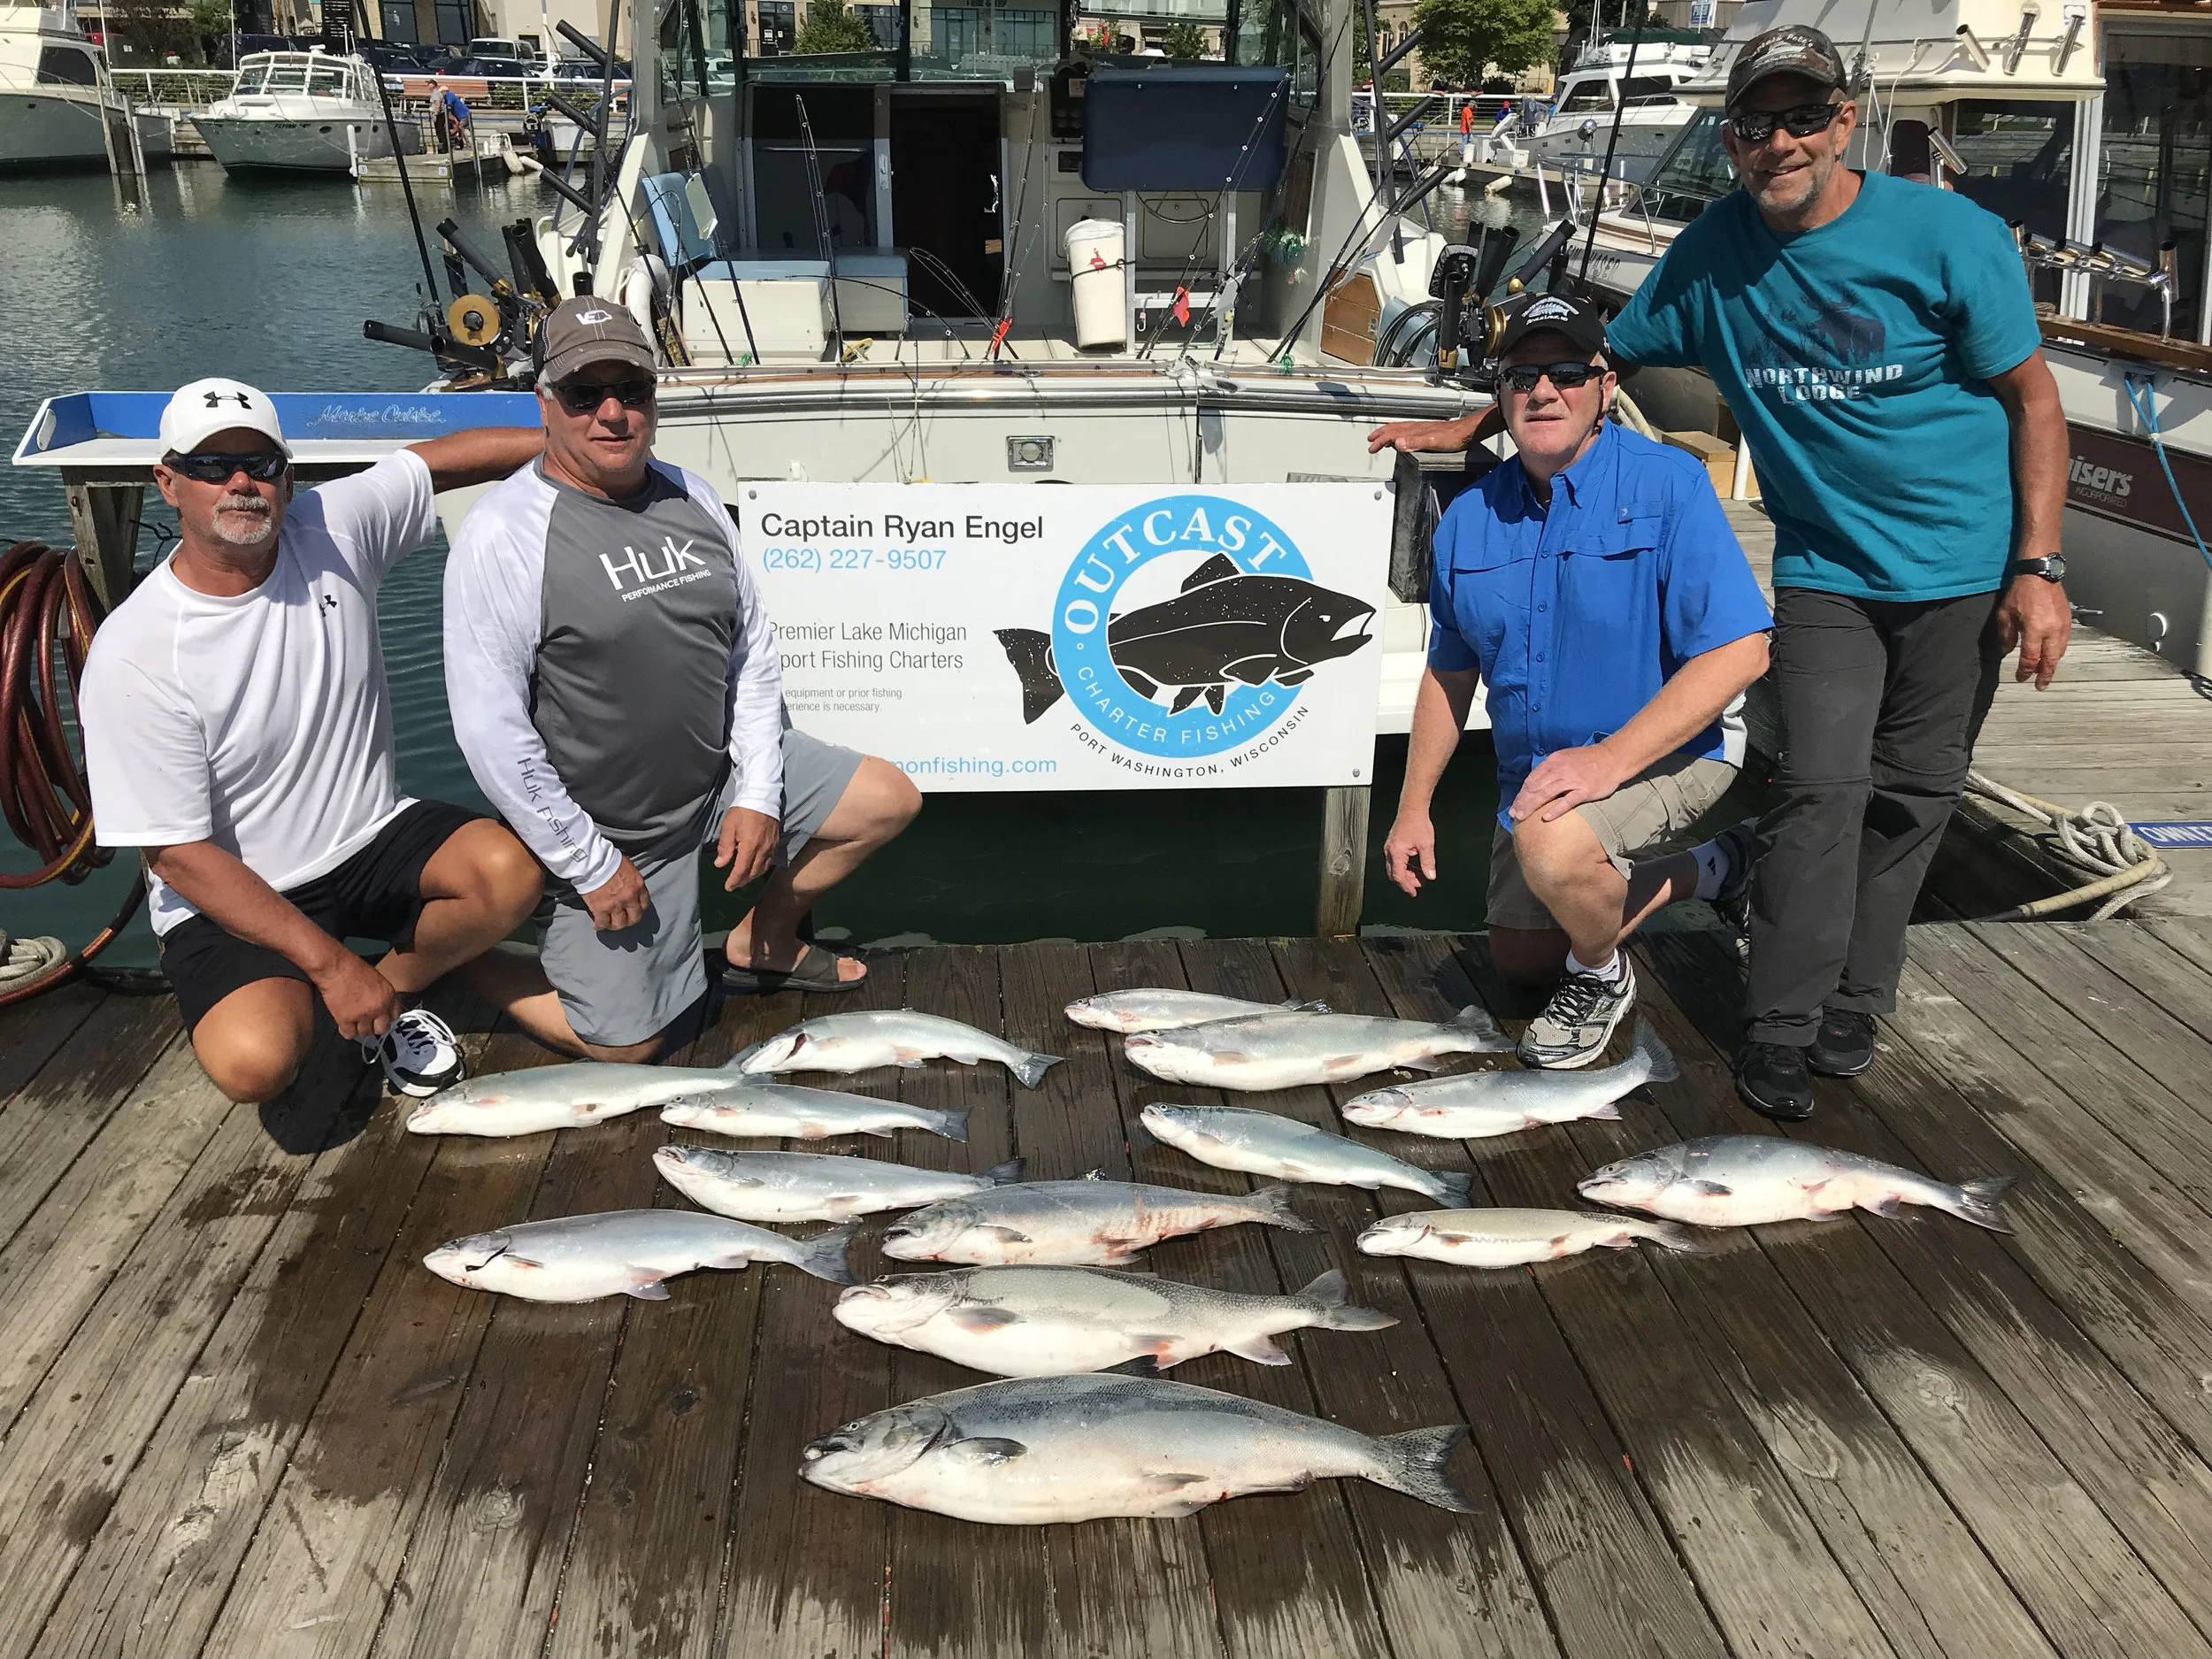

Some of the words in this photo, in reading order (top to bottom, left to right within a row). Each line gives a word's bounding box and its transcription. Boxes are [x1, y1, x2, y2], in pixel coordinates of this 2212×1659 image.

[1745, 364, 1904, 388] NORTHWIND
[1777, 383, 1863, 405] LODGE
[307, 404, 380, 427] Marine
[2075, 486, 2127, 508] INCORPORATED
[760, 512, 874, 542] Captain
[884, 514, 955, 544] Ryan
[965, 515, 1043, 545] Engel
[763, 548, 821, 573] (262)
[829, 549, 947, 570] 227-9507
[1064, 507, 1287, 634] OUTCAST
[679, 569, 712, 585] FISHING
[841, 622, 883, 641] Lake
[889, 622, 967, 645] Michigan
[777, 651, 816, 672] port
[822, 650, 883, 672] Fishing
[889, 650, 964, 669] Charters
[785, 687, 833, 699] equipment
[848, 687, 869, 700] prior
[872, 687, 902, 700] fishing
[1078, 666, 1167, 743] CHARTER
[1181, 691, 1276, 744] FISHING
[780, 702, 820, 712] perience
[823, 701, 832, 711] is
[1070, 723, 1108, 755] PORT
[1110, 752, 1225, 778] WASHINGTON,
[1230, 705, 1309, 768] WISCONSIN
[891, 757, 1057, 778] monfishing.com
